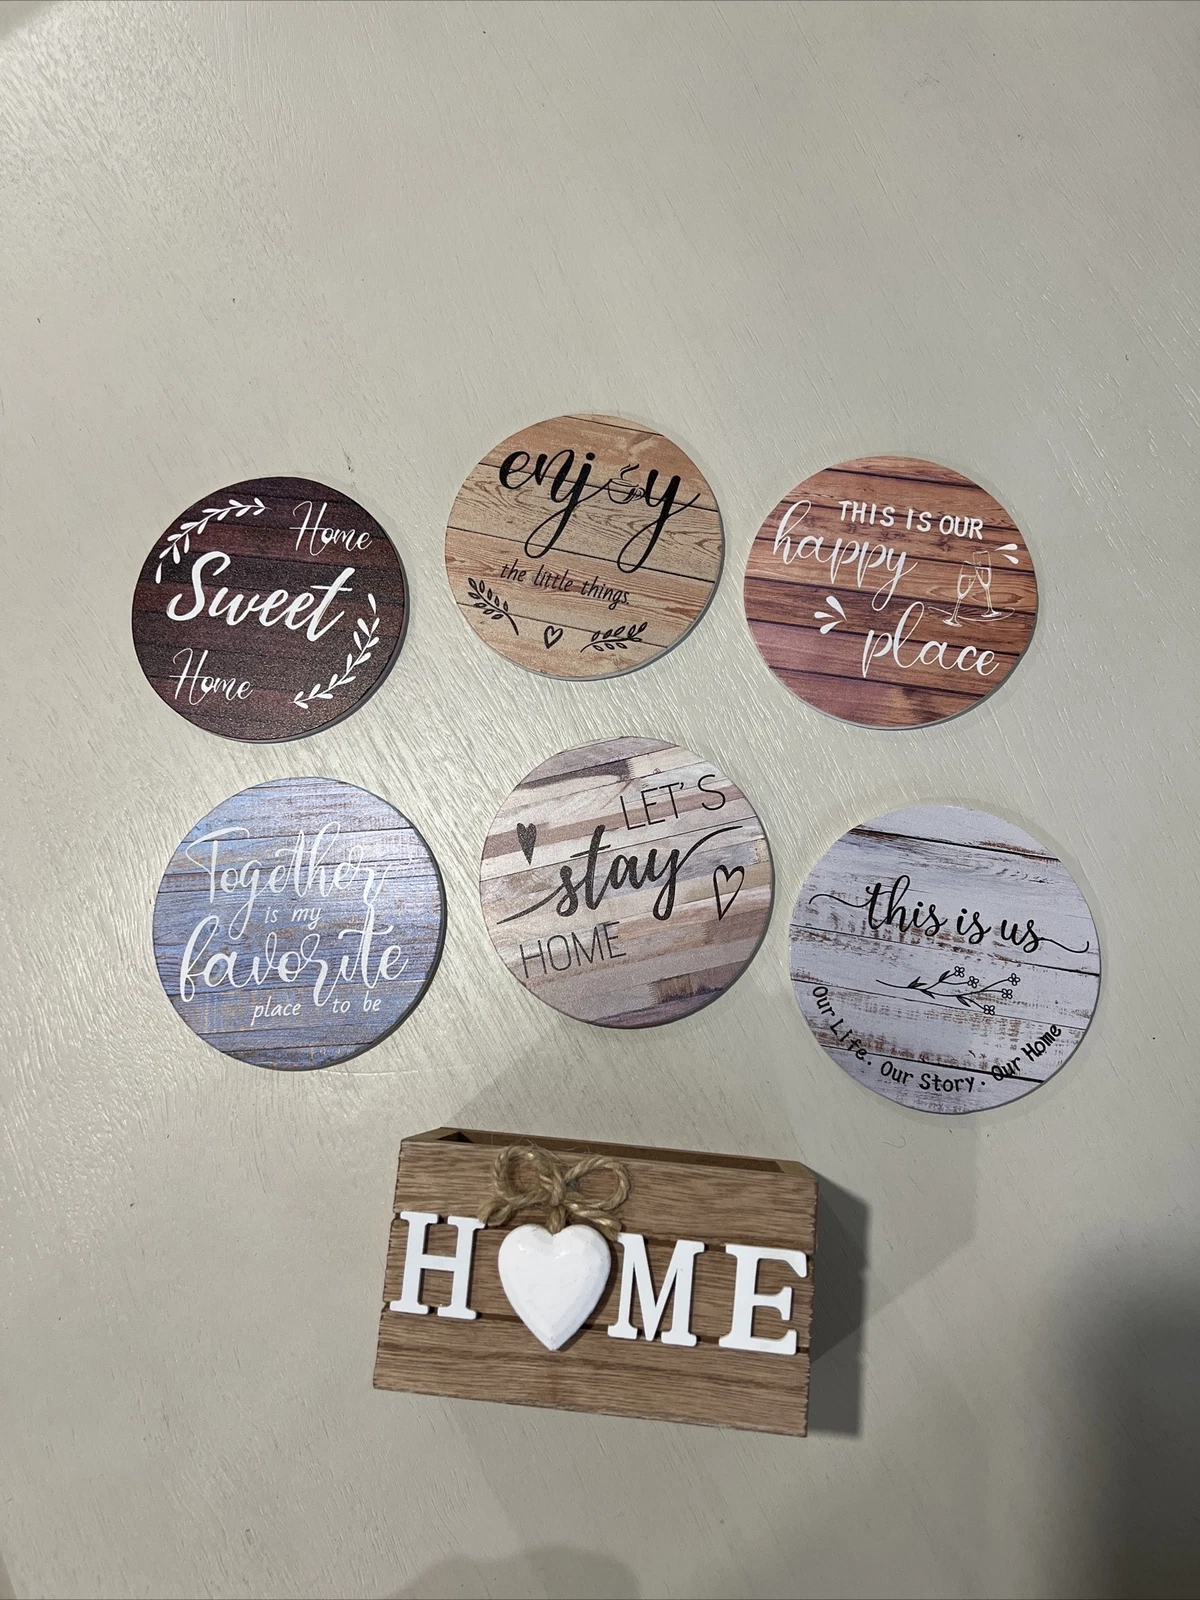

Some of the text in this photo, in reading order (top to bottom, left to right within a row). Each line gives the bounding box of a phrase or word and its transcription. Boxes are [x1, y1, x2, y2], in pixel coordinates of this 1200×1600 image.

[289, 500, 372, 556] Home
[772, 500, 918, 612] happy
[838, 500, 984, 540] THIS IS OUR
[166, 551, 355, 642] Sweet
[500, 559, 630, 610] the little things.
[169, 647, 253, 705] Home
[861, 601, 1000, 678] place
[185, 821, 413, 940] Together
[496, 824, 744, 921] stay
[264, 906, 322, 930] is my
[519, 920, 627, 979] HOME
[808, 874, 1090, 954] this is us
[179, 903, 409, 1007] favorite
[250, 990, 382, 1026] place to be
[812, 986, 835, 1017] Our
[880, 1060, 914, 1085] Our
[991, 1055, 1022, 1081] Our
[1024, 1023, 1062, 1063] Home
[389, 1210, 808, 1356] HME
